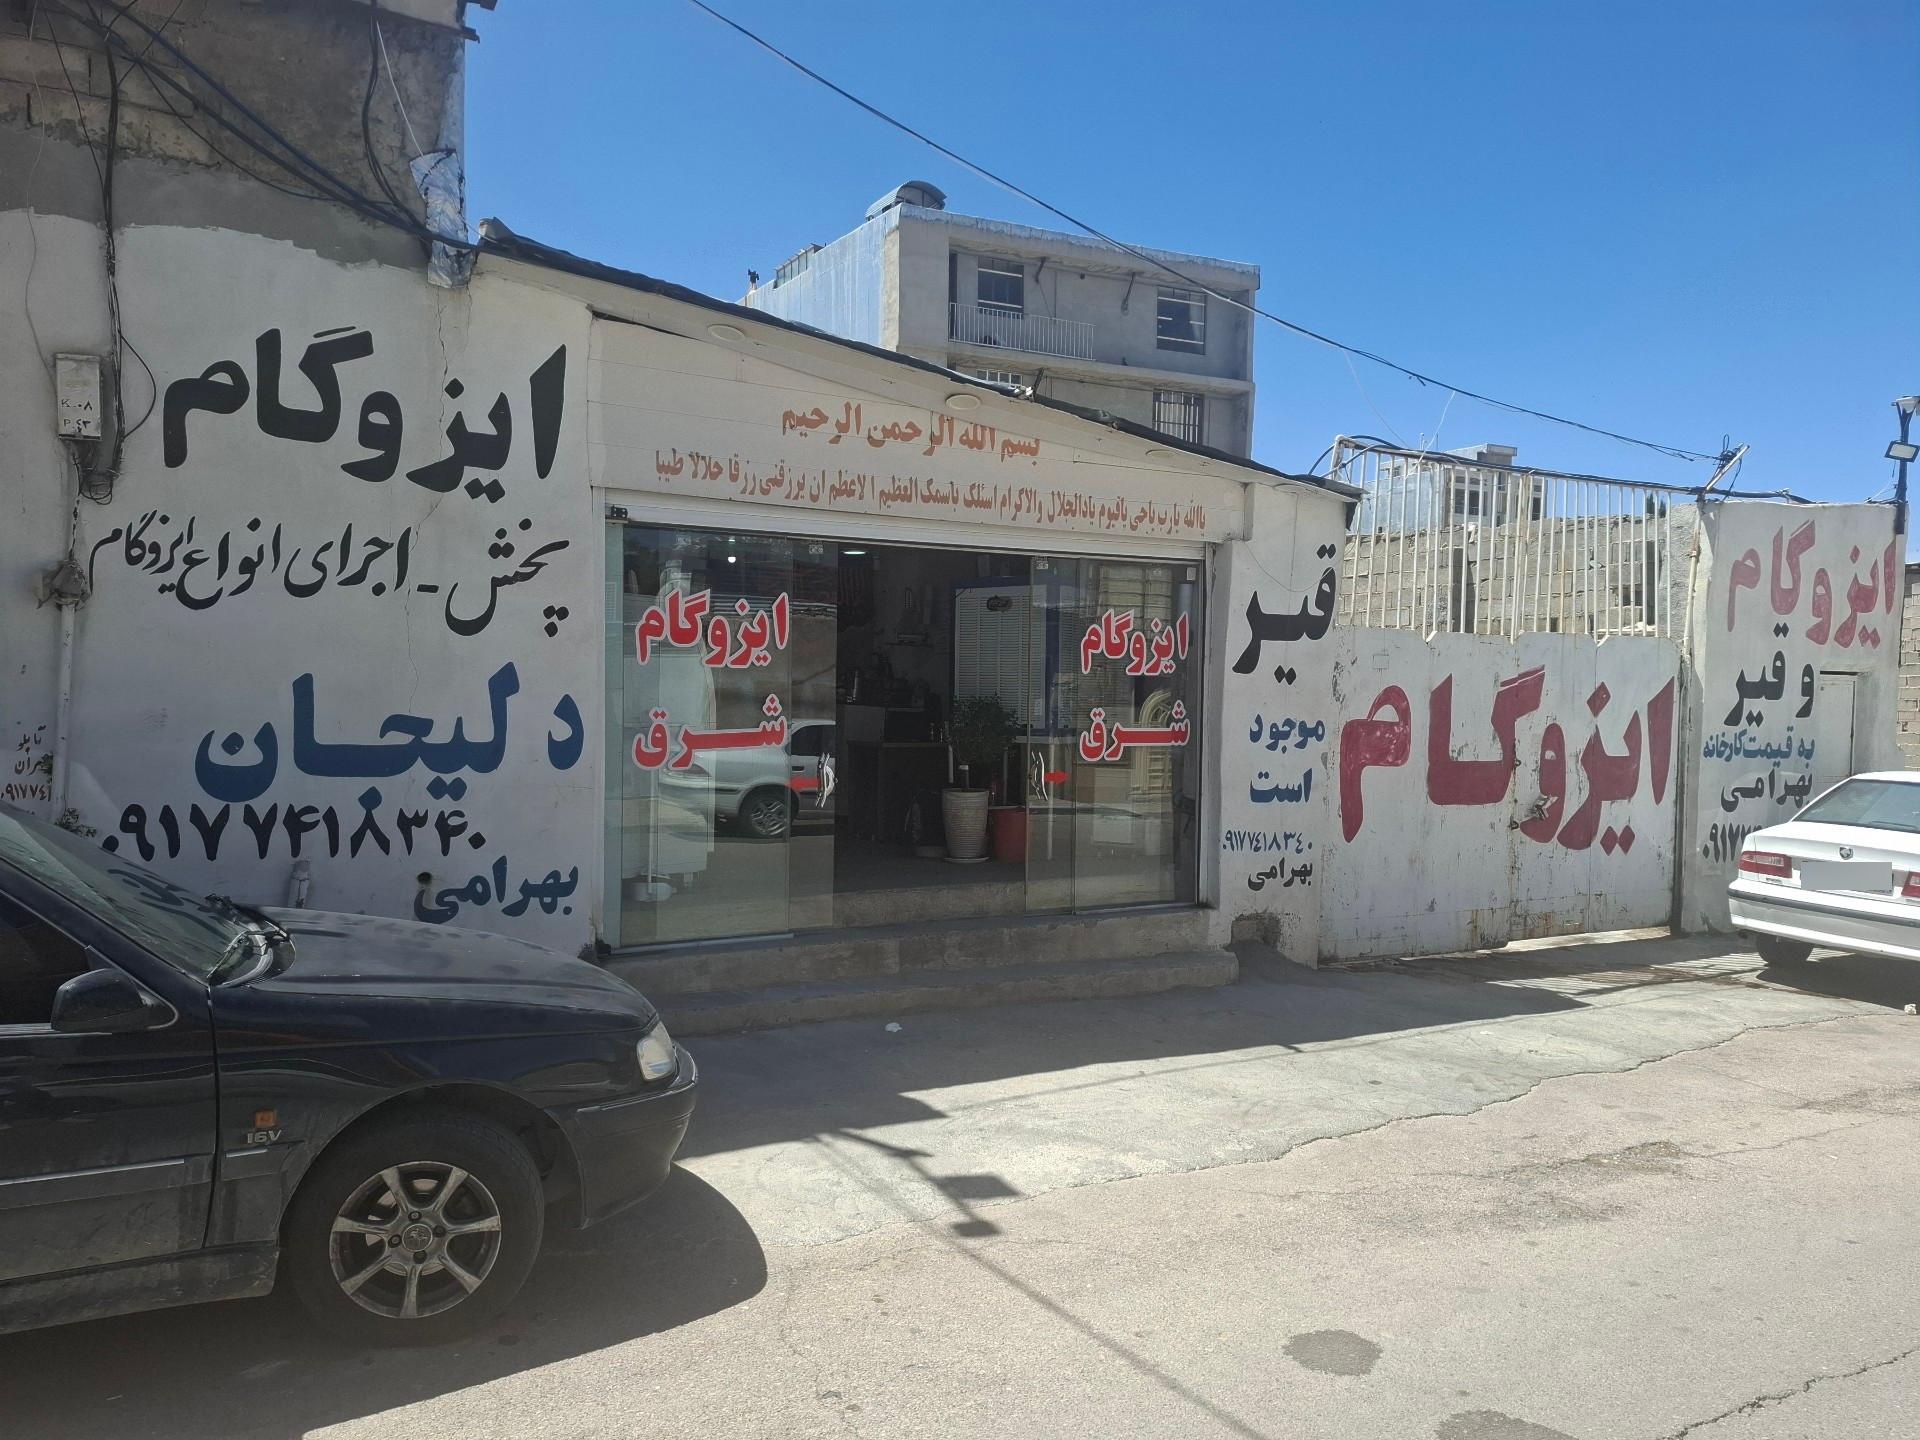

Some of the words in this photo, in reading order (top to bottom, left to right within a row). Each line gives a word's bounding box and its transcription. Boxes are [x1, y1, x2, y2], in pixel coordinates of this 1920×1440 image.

[163, 325, 567, 503] ایزوگام
[782, 401, 862, 445] الرحیم
[867, 413, 954, 457] الرحمن
[959, 422, 996, 452] الله
[1001, 438, 1040, 467] بسم
[88, 509, 197, 597] ایزوگام
[176, 517, 282, 611] انواع
[284, 522, 412, 599] اجرای
[445, 518, 570, 638] پخش
[1727, 519, 1897, 649] ایزوگام
[635, 589, 790, 668] ایزوگام
[1080, 608, 1190, 676] ایزوگام
[1232, 543, 1337, 686] قیر
[1724, 622, 1790, 728] قیر
[1796, 663, 1815, 718] و
[195, 661, 585, 811] دلیجان
[632, 694, 788, 770] شرق
[1080, 699, 1190, 762] شرق
[1250, 714, 1325, 754] موجود
[1340, 664, 1675, 856] ایزوگام
[1703, 728, 1748, 763] کارخانه
[1743, 725, 1794, 768] قیمت
[1797, 736, 1816, 769] به
[1250, 768, 1312, 803] است
[1720, 769, 1813, 813] بهرامی
[413, 855, 578, 924] بهرامی
[1248, 857, 1313, 892] بهرامی
[247, 1129, 282, 1144] 16V
